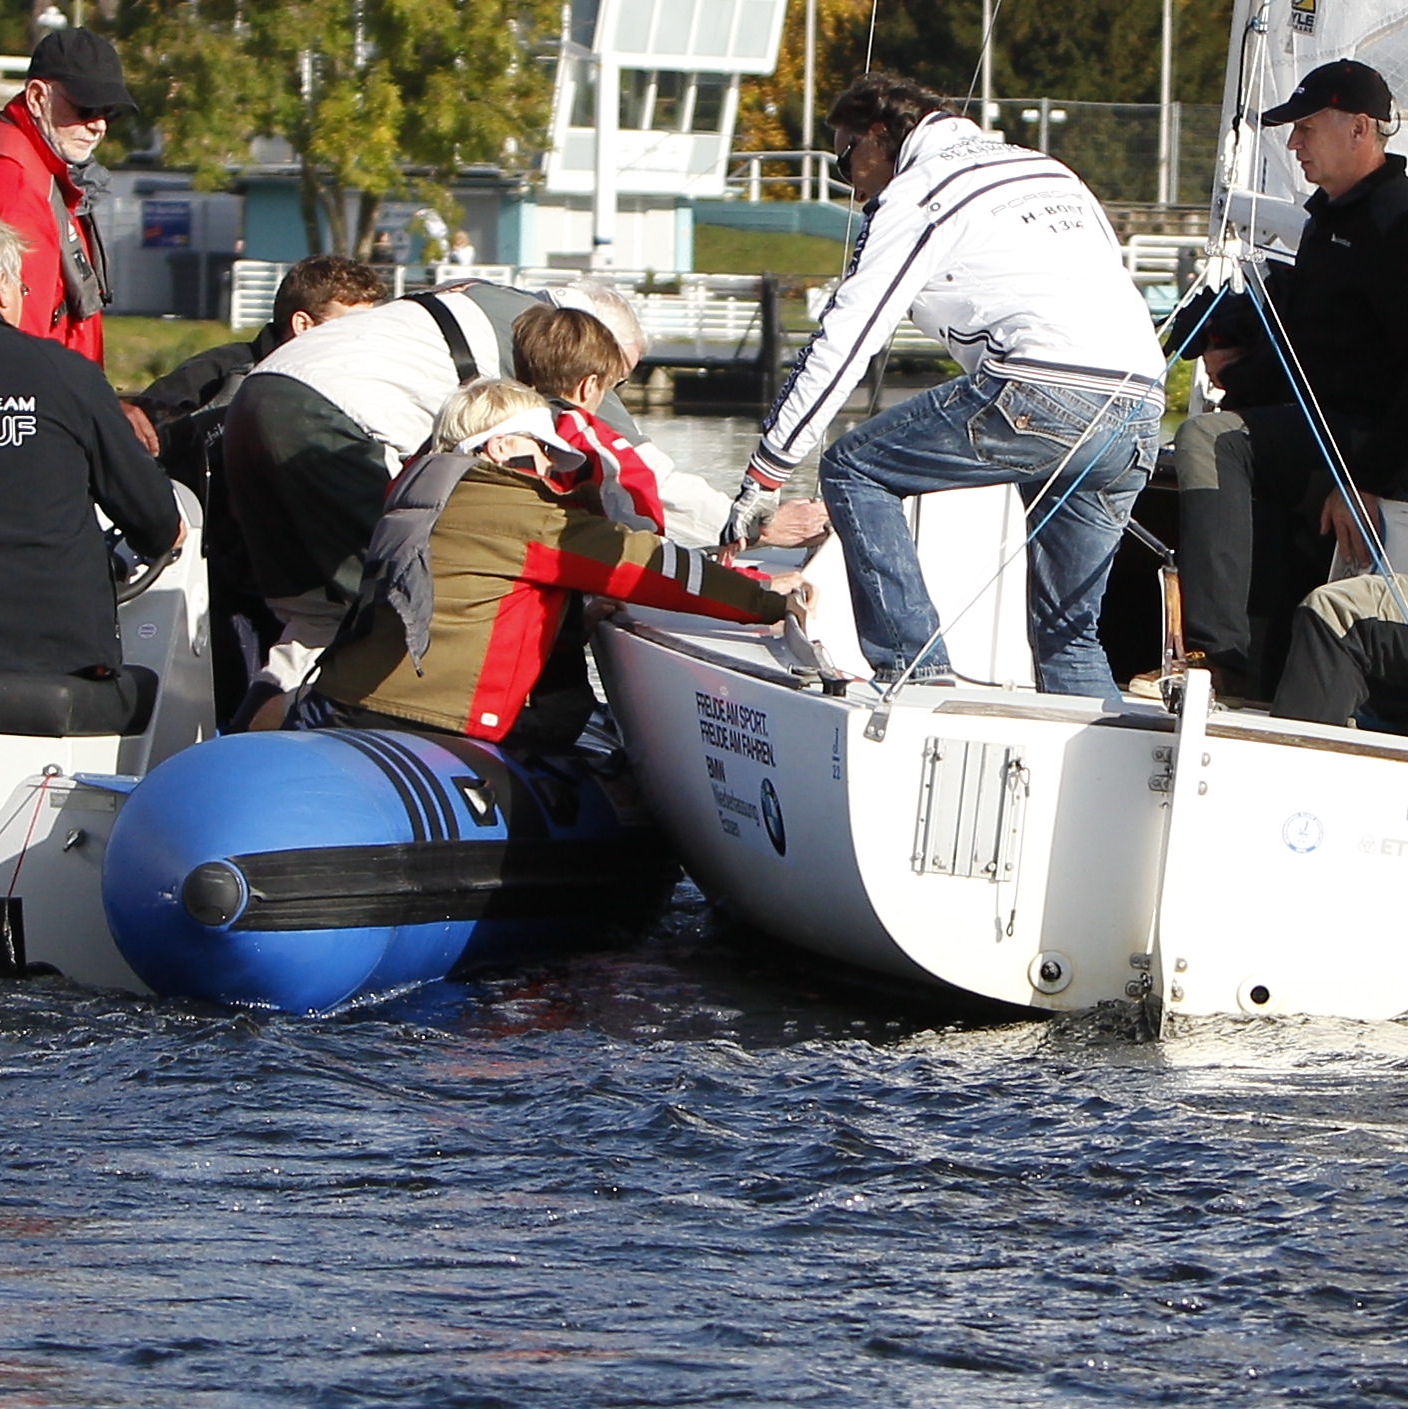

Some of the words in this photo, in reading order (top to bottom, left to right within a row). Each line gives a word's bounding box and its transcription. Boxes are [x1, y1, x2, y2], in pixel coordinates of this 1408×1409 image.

[695, 692, 725, 721] FREUDE
[726, 702, 738, 726] AM
[699, 720, 729, 750] FREUDE
[729, 727, 742, 754] AM
[705, 755, 726, 782] BMW
